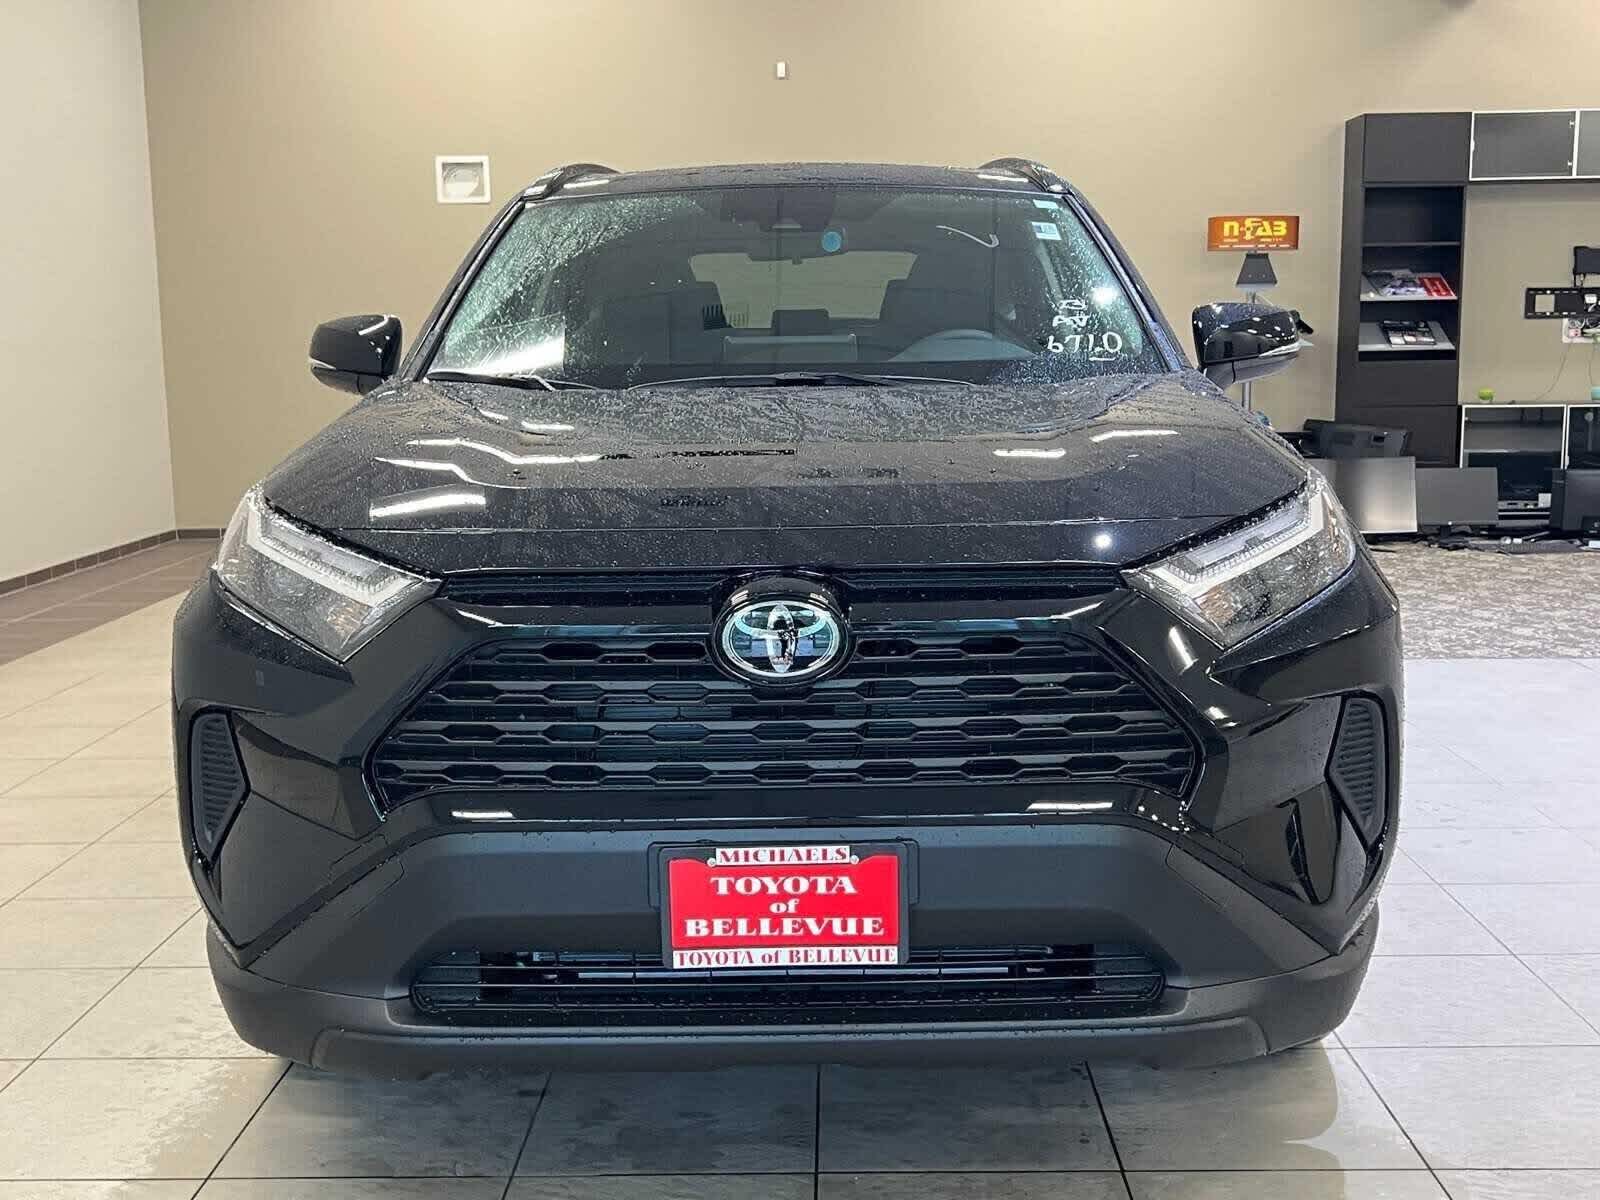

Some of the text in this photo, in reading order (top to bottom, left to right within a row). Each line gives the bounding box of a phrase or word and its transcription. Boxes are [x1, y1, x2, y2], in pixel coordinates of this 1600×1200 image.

[719, 847, 847, 864] MICHAELS
[710, 876, 857, 895] TOYOTA
[769, 898, 799, 914] of
[684, 917, 884, 937] BELLEVUE
[676, 947, 895, 967] TOYOTA of BELLEVUE
